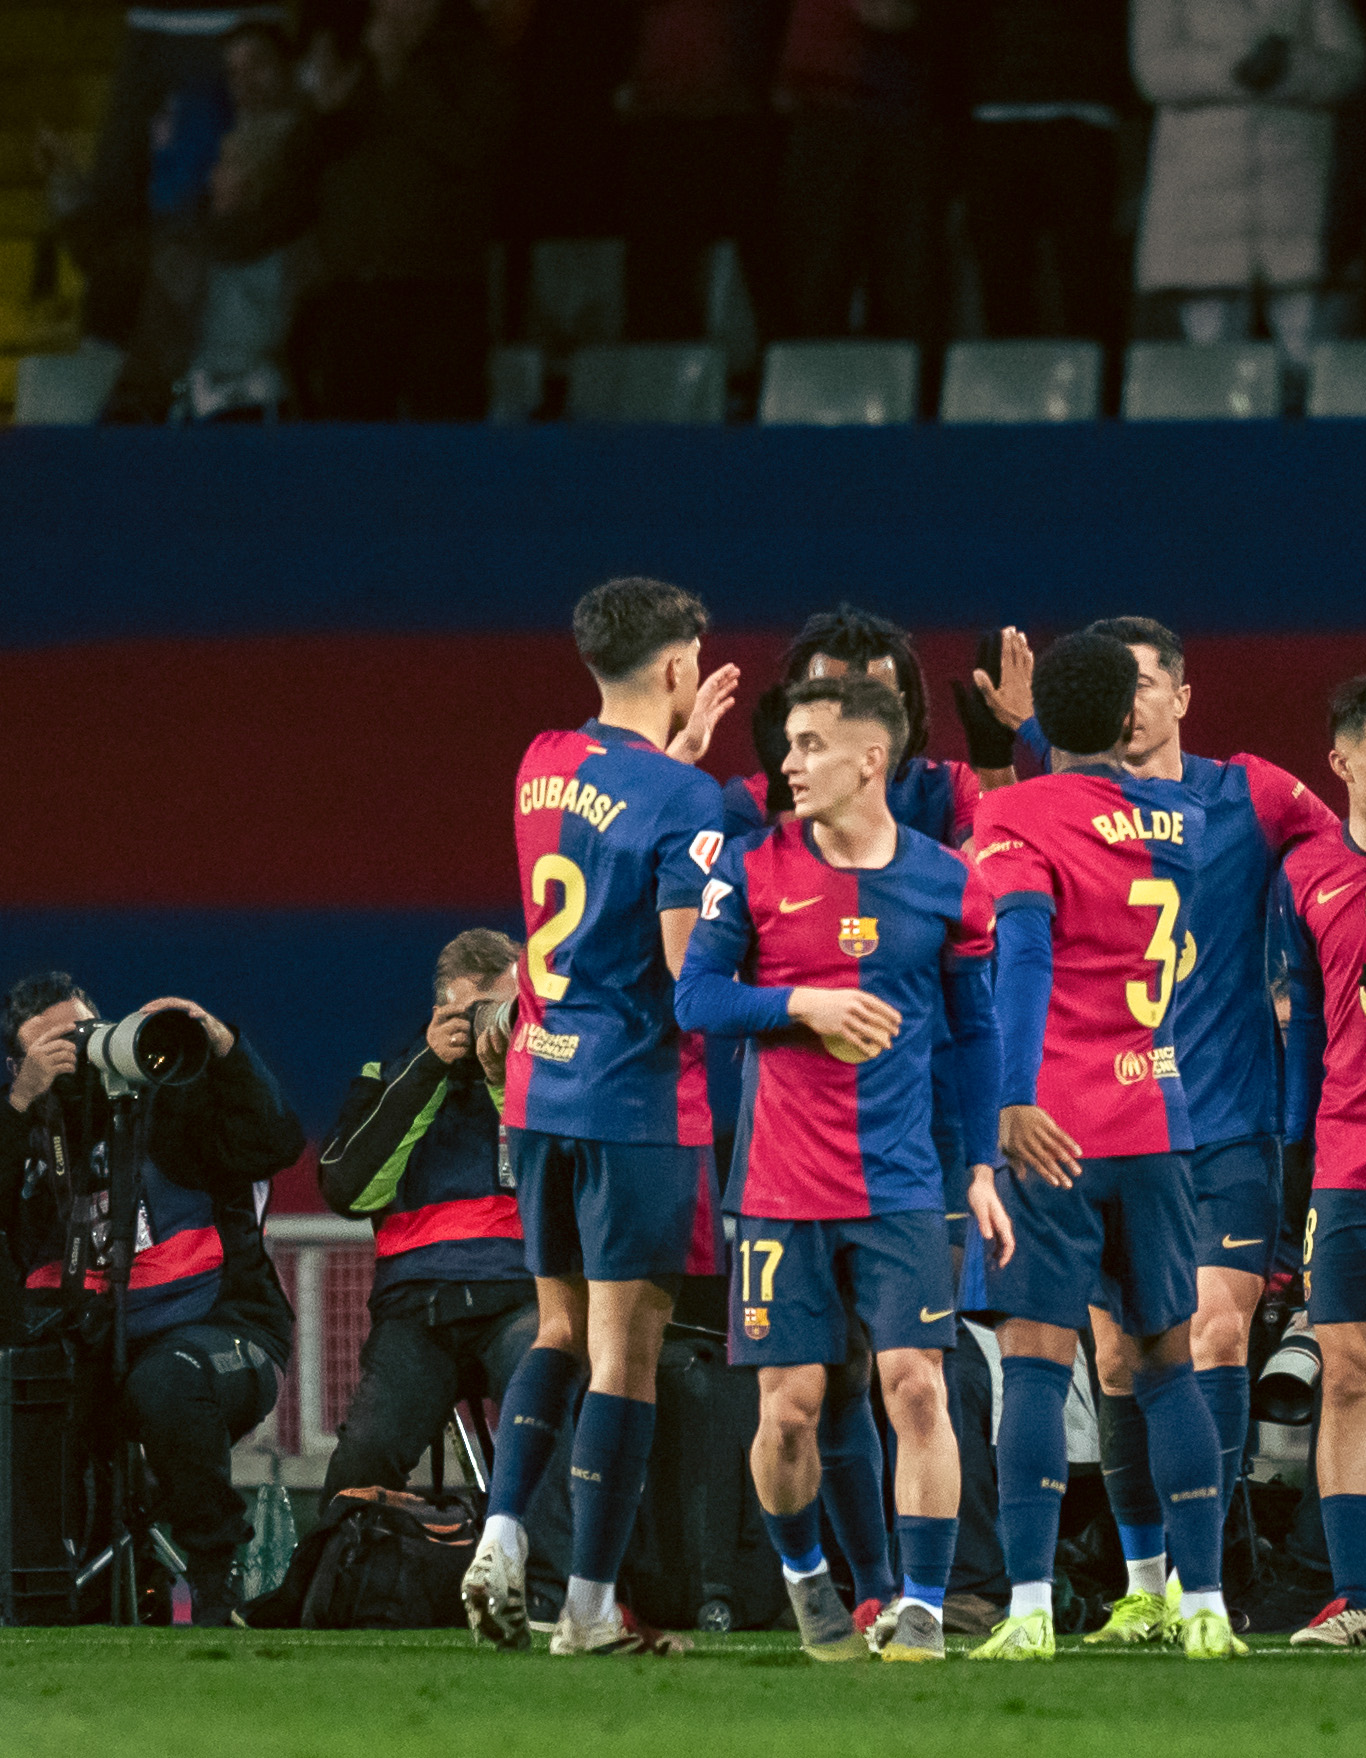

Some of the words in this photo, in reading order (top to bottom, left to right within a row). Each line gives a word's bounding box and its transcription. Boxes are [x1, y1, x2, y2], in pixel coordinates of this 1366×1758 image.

[520, 775, 627, 833] CUBARSÍ
[1091, 807, 1184, 845] BALDE
[527, 854, 586, 1001] 2
[1126, 879, 1180, 1028] 3
[1303, 1208, 1317, 1265] 8
[740, 1239, 784, 1302] 17
